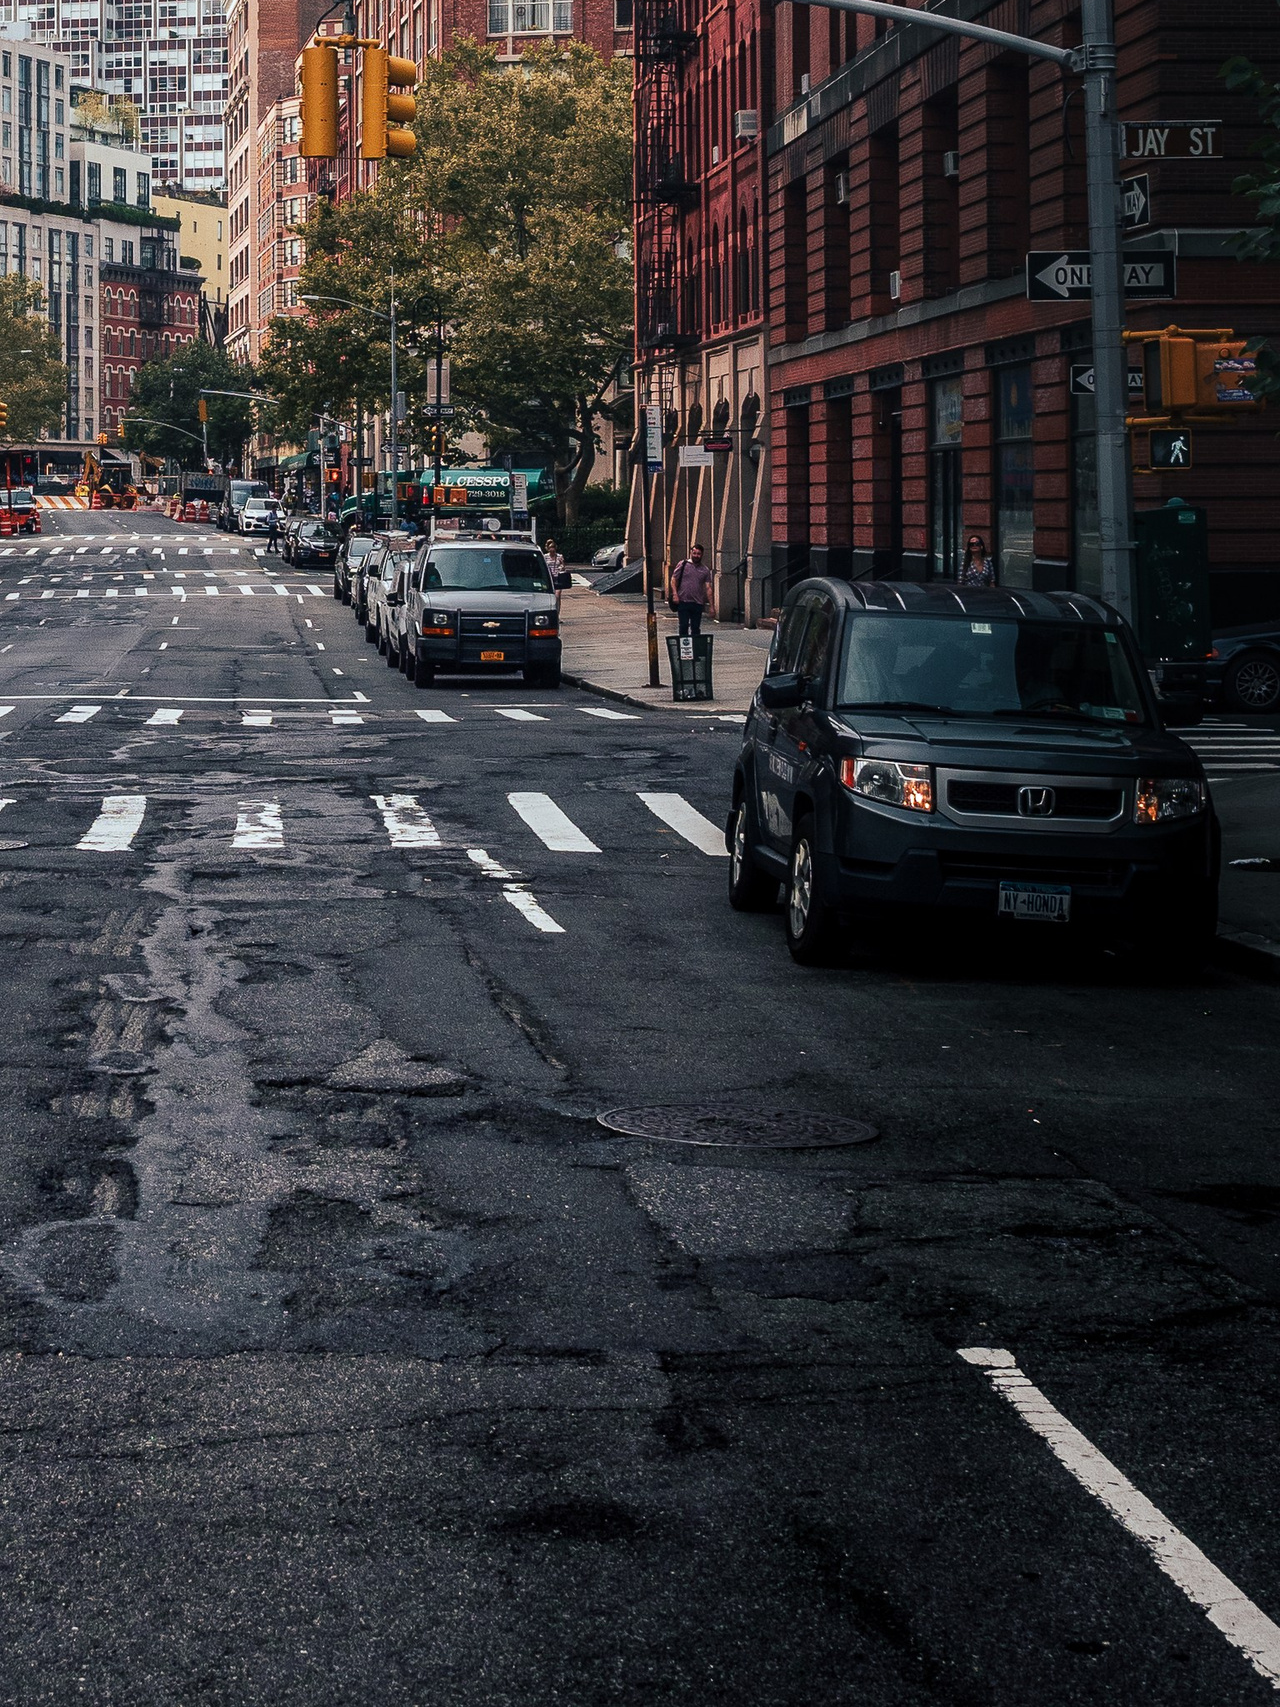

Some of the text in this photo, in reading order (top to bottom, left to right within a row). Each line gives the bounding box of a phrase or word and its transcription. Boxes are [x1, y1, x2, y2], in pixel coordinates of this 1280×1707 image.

[1131, 127, 1216, 157] JAY ST
[1126, 266, 1154, 284] AY
[429, 476, 453, 487] AL
[467, 490, 505, 498] 729-3018
[1027, 894, 1064, 913] HONDA
